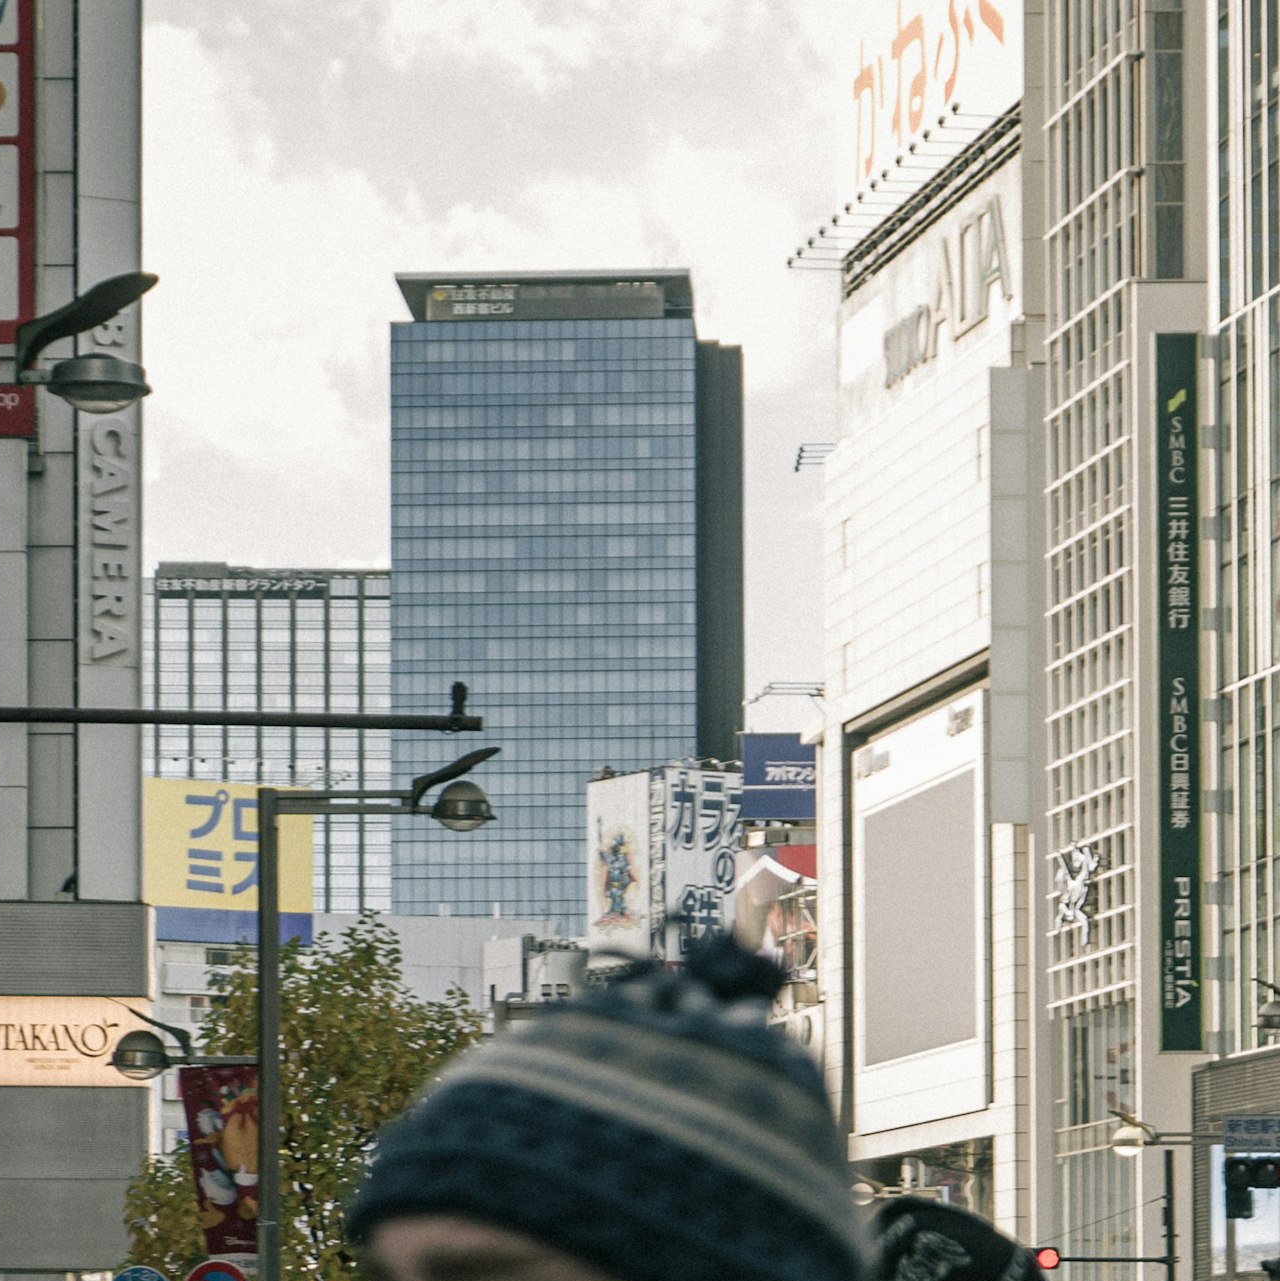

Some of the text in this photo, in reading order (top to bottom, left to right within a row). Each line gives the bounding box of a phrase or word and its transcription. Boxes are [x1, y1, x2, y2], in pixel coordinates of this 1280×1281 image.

[1170, 416, 1187, 485] SMBC
[91, 418, 129, 662] CAMERA
[1167, 496, 1191, 629] 三井住友銀行
